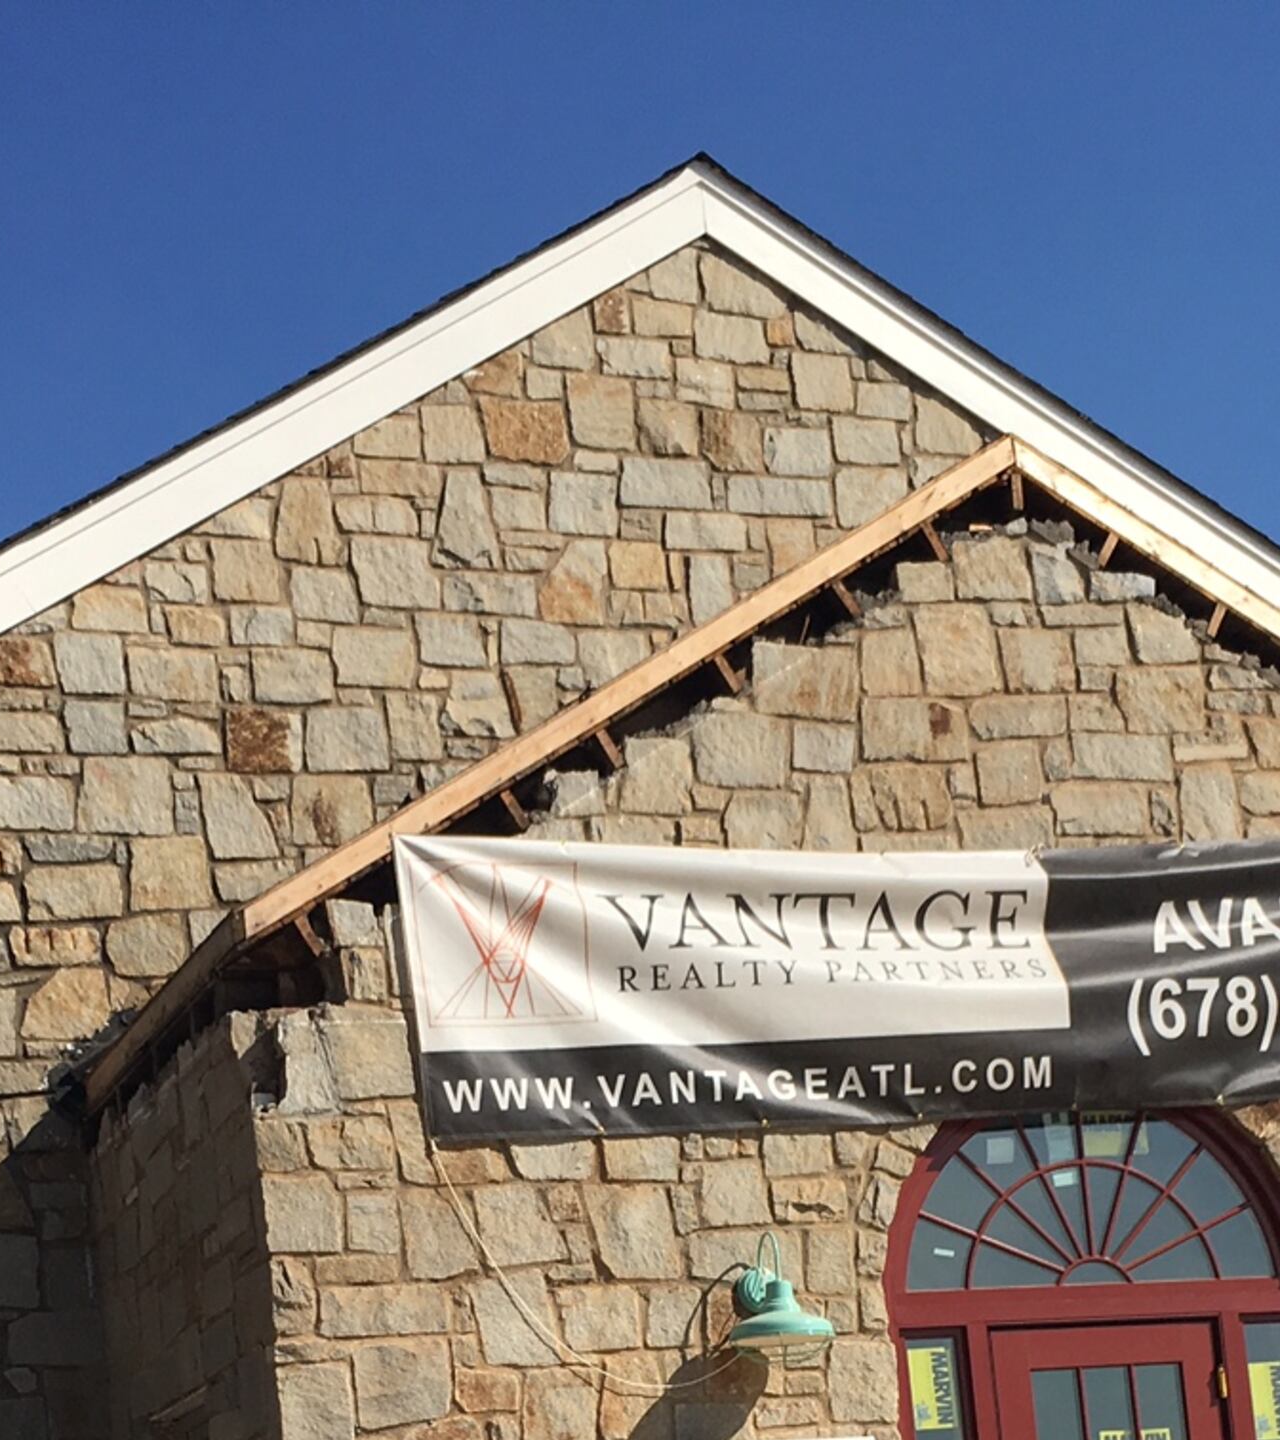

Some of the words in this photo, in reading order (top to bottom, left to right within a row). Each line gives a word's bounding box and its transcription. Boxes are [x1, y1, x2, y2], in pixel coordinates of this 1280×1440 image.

[596, 888, 1032, 953] VANTAGE
[616, 958, 799, 993] REALTY
[825, 957, 1049, 984] PARTNERS
[1126, 973, 1279, 1057] (678)
[442, 1054, 1055, 1115] WWW.VANTAGEATL.COM
